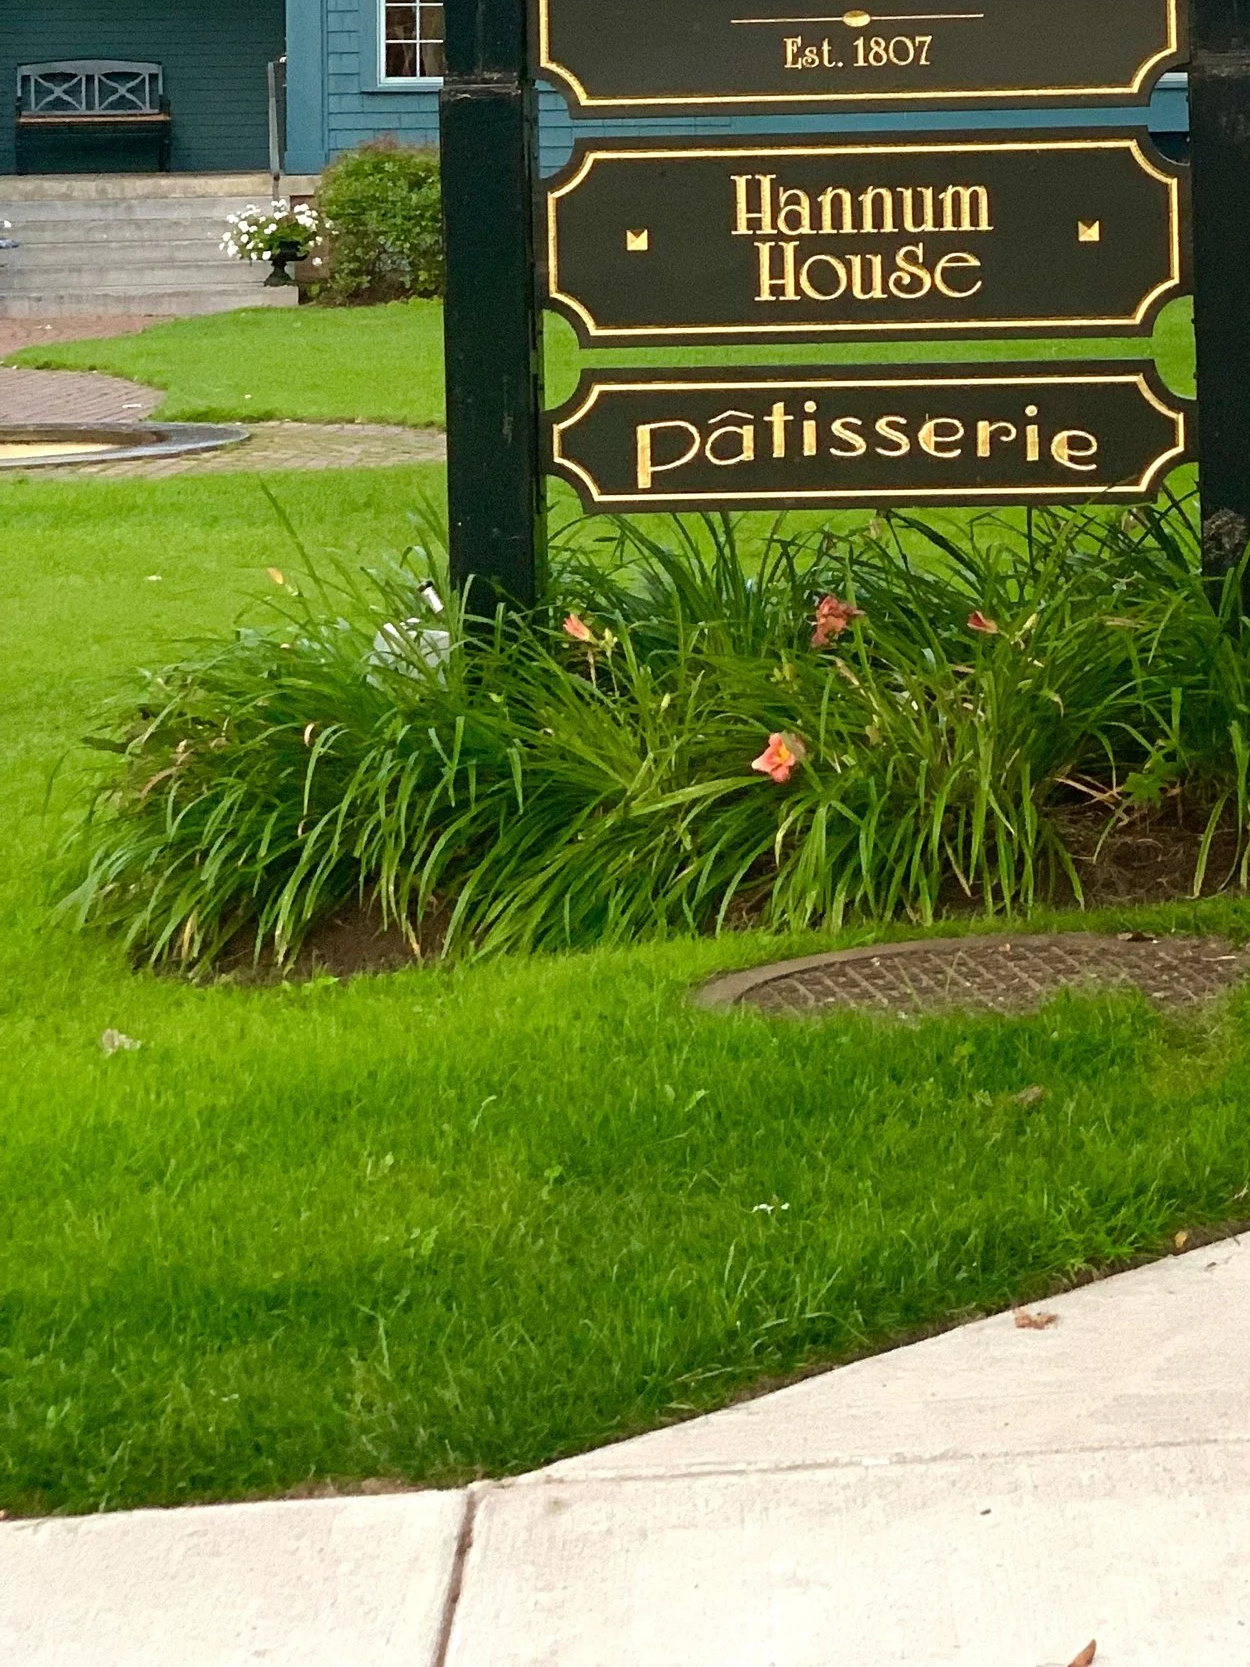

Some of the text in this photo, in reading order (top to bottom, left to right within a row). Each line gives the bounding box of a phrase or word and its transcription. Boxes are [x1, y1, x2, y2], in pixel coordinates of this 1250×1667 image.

[783, 35, 933, 70] Est. 1807
[729, 173, 994, 236] Hannum
[753, 240, 983, 302] House
